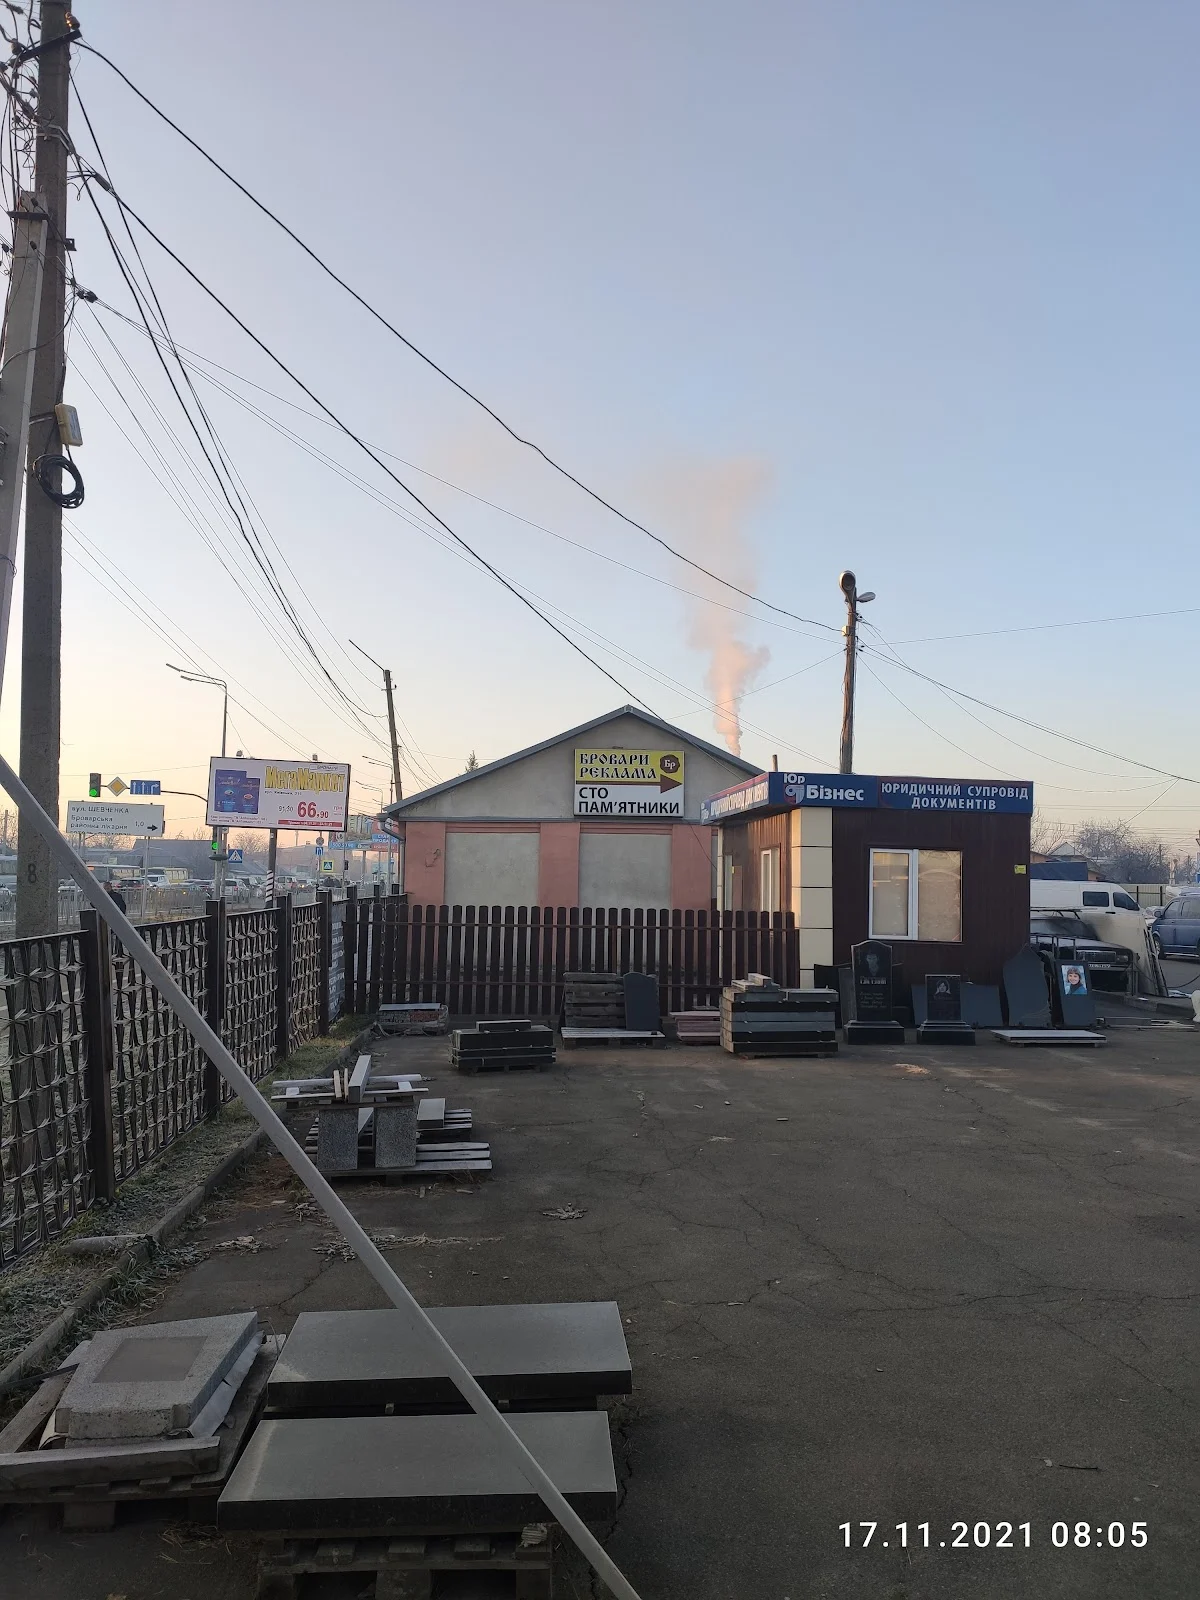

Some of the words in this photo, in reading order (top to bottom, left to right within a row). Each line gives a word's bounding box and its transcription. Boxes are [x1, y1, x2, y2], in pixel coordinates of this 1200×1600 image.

[580, 753, 650, 765] БРОВАРИ
[663, 759, 676, 770] Бр
[580, 767, 657, 779] РЕКЛАМА
[783, 773, 806, 784] Юр
[578, 787, 609, 799] СТО
[806, 784, 865, 801] Бізнес
[881, 782, 961, 796] ЮРИДИЧНИЙ
[967, 785, 1029, 800] СУПРОВІД
[911, 797, 997, 810] ДОКУМЕНТІВ
[88, 806, 130, 814] ШЕВЧЕНКА
[71, 814, 113, 823] Броварська
[27, 863, 37, 884] 8
